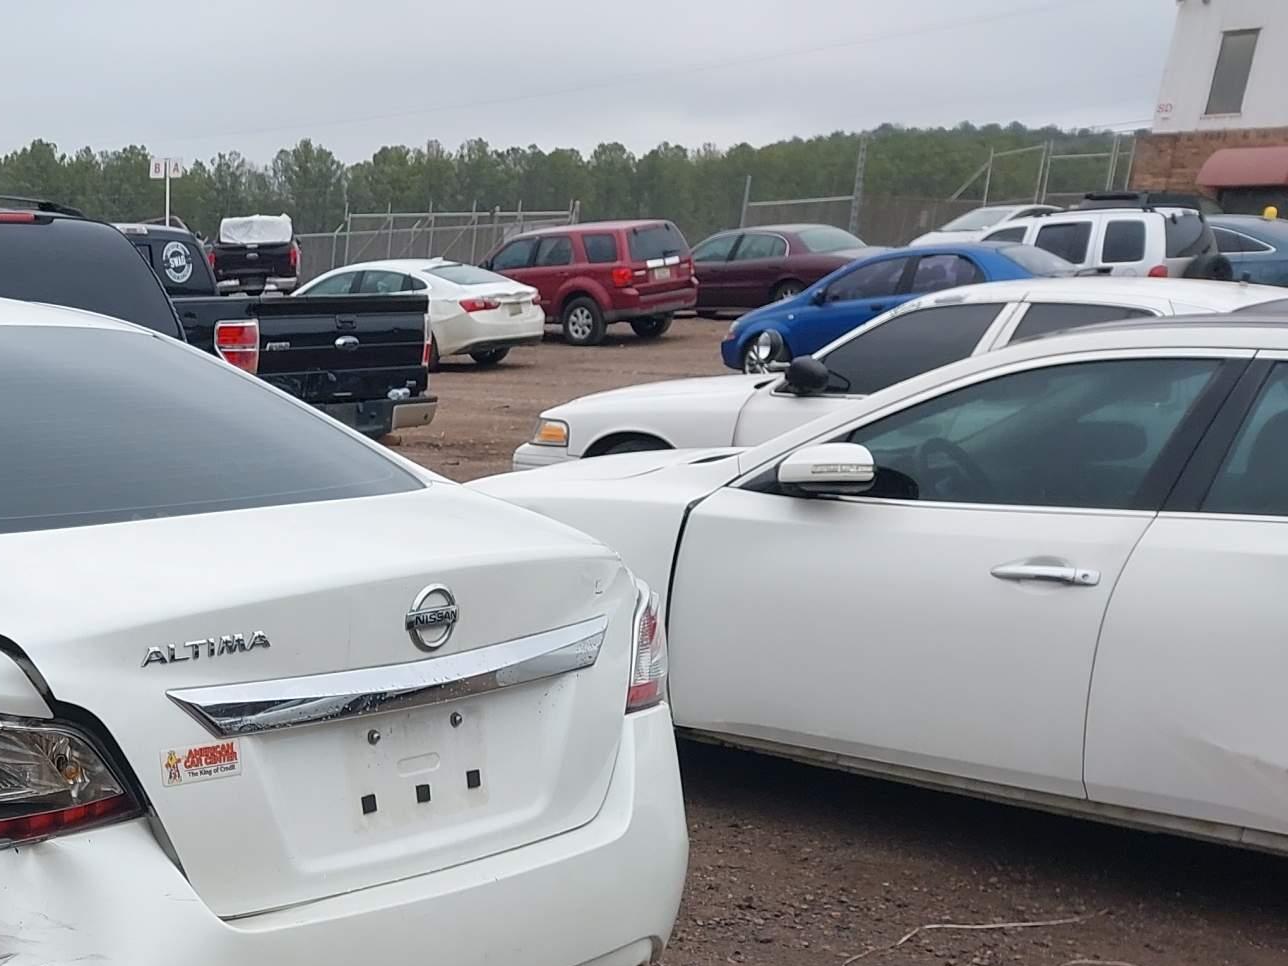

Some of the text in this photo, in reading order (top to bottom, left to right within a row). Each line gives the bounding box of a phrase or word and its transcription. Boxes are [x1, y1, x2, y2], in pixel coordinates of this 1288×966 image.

[154, 162, 161, 174] B
[172, 162, 180, 173] A
[415, 610, 457, 625] NISSAN
[140, 630, 271, 668] ALTIMA
[186, 742, 235, 759] AMERICAN
[184, 752, 238, 769] CAR CENTER
[199, 769, 213, 777] King
